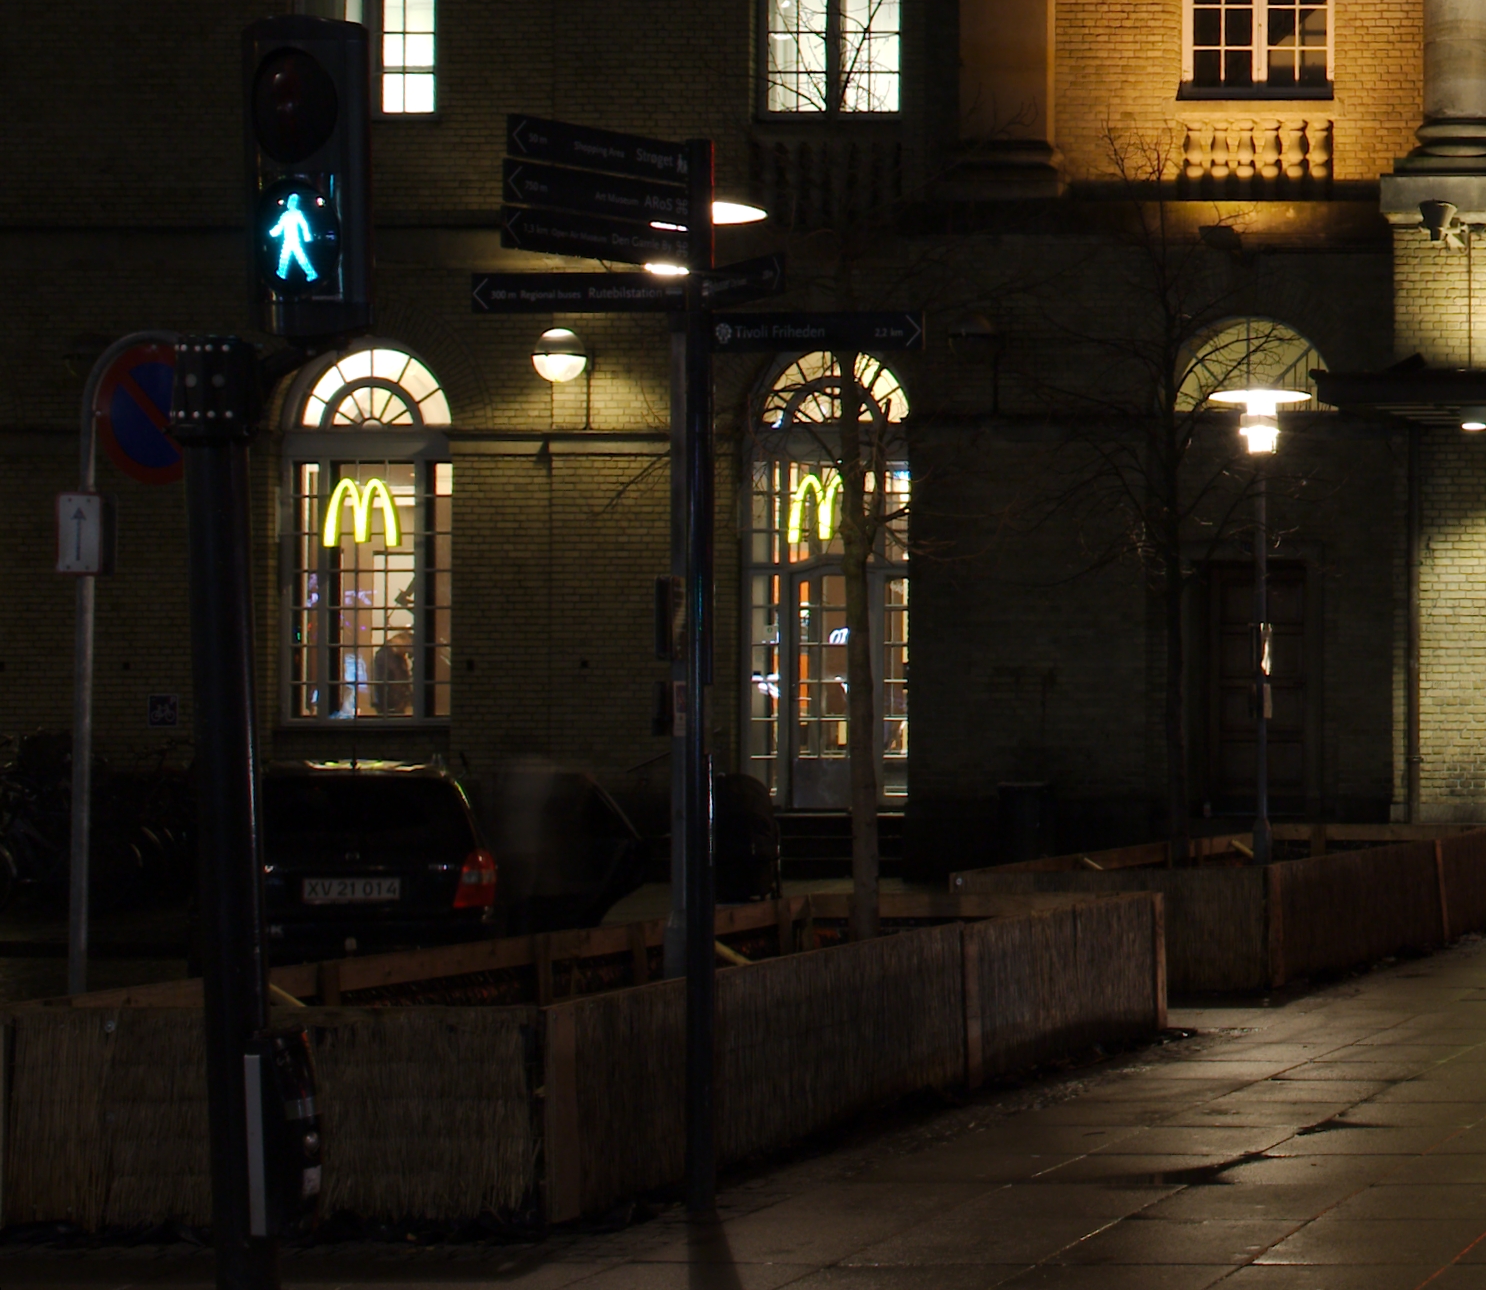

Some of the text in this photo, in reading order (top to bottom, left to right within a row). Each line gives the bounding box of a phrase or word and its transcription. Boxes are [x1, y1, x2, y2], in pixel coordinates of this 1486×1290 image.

[528, 133, 539, 144] 50
[573, 140, 608, 157] Shopping
[608, 147, 626, 158] Area
[636, 147, 674, 167] Strøget
[595, 191, 607, 201] Art
[607, 194, 639, 206] Museum
[644, 194, 673, 211] ARoS
[612, 232, 629, 246] Den
[631, 236, 660, 249] Gamle
[661, 241, 672, 254] By
[491, 289, 507, 299] 300
[520, 289, 555, 302] Regional
[558, 289, 581, 299] buses
[588, 287, 663, 299] Rutebilstation
[734, 325, 768, 338] Tivoli
[772, 324, 825, 338] Friheden
[890, 328, 903, 337] km
[308, 882, 332, 896] XV
